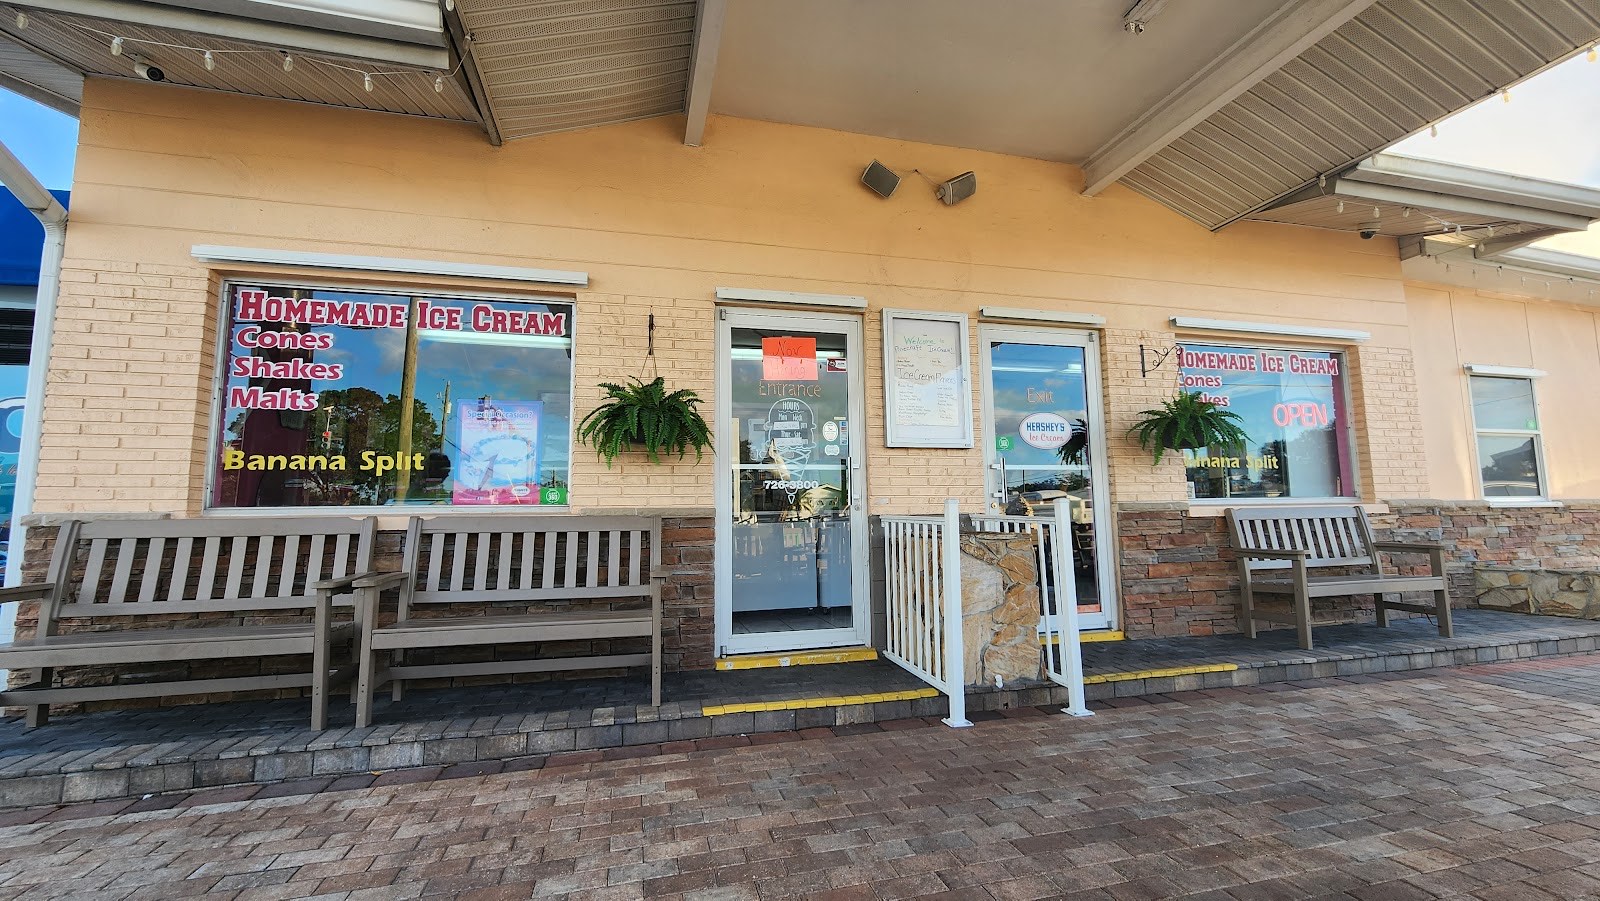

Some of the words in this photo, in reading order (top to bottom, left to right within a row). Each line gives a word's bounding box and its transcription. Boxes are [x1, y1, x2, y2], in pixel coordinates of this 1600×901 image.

[236, 326, 334, 350] Cones
[904, 336, 936, 345] Welcome
[233, 356, 344, 380] Shakes
[759, 381, 821, 397] Entrance
[1026, 387, 1054, 404] Exit
[230, 386, 320, 411] Malts
[782, 401, 800, 411] HOURS
[467, 409, 494, 420] Special
[1272, 402, 1328, 427] OPEN
[1026, 421, 1065, 432] HERSHEY'S
[1029, 433, 1038, 441] Ice
[1040, 433, 1064, 442] Cream
[224, 450, 346, 470] Banana
[360, 451, 425, 477] Split
[1246, 454, 1279, 473] Split
[764, 480, 819, 490] 726-3800
